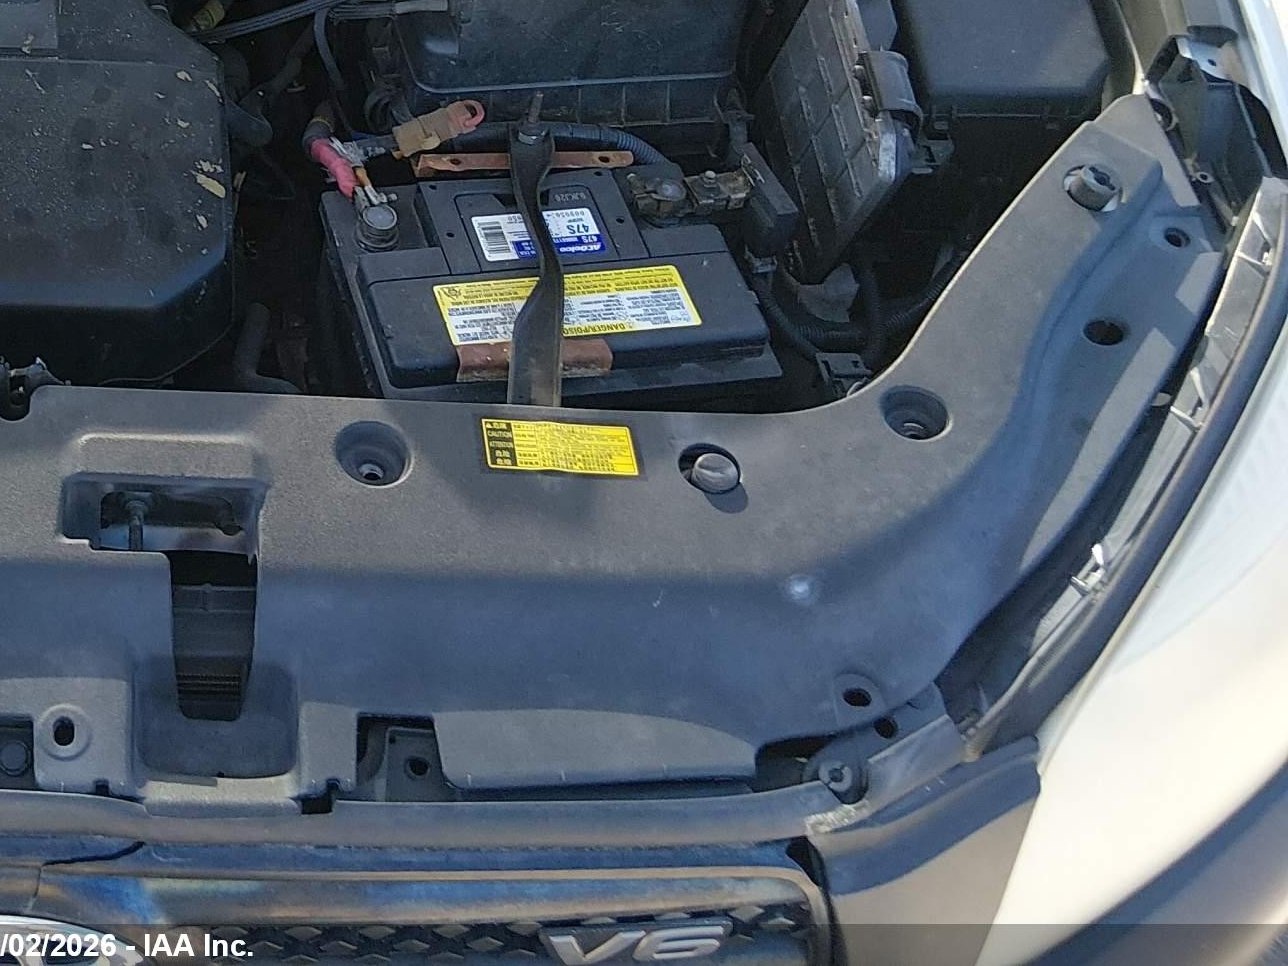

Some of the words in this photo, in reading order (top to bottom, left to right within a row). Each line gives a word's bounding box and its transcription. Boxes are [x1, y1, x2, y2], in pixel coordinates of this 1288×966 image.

[566, 223, 590, 235] 47S
[562, 322, 626, 336] DANGER/POISO
[549, 926, 725, 966] V6
